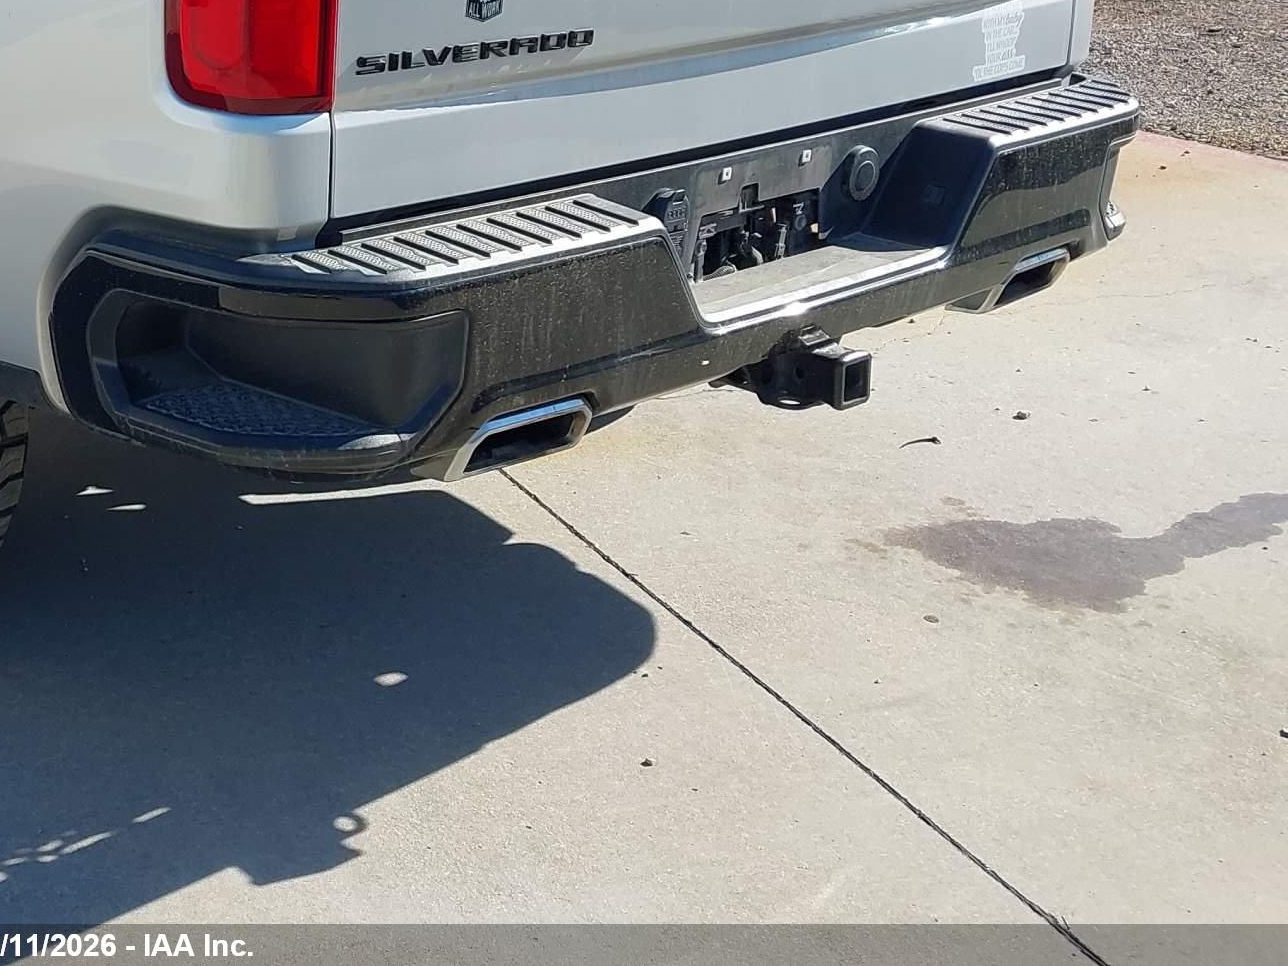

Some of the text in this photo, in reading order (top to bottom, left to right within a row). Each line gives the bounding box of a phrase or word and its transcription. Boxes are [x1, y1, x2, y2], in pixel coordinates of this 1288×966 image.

[468, 0, 501, 19] ALL WORK
[355, 29, 596, 75] SILVERADO
